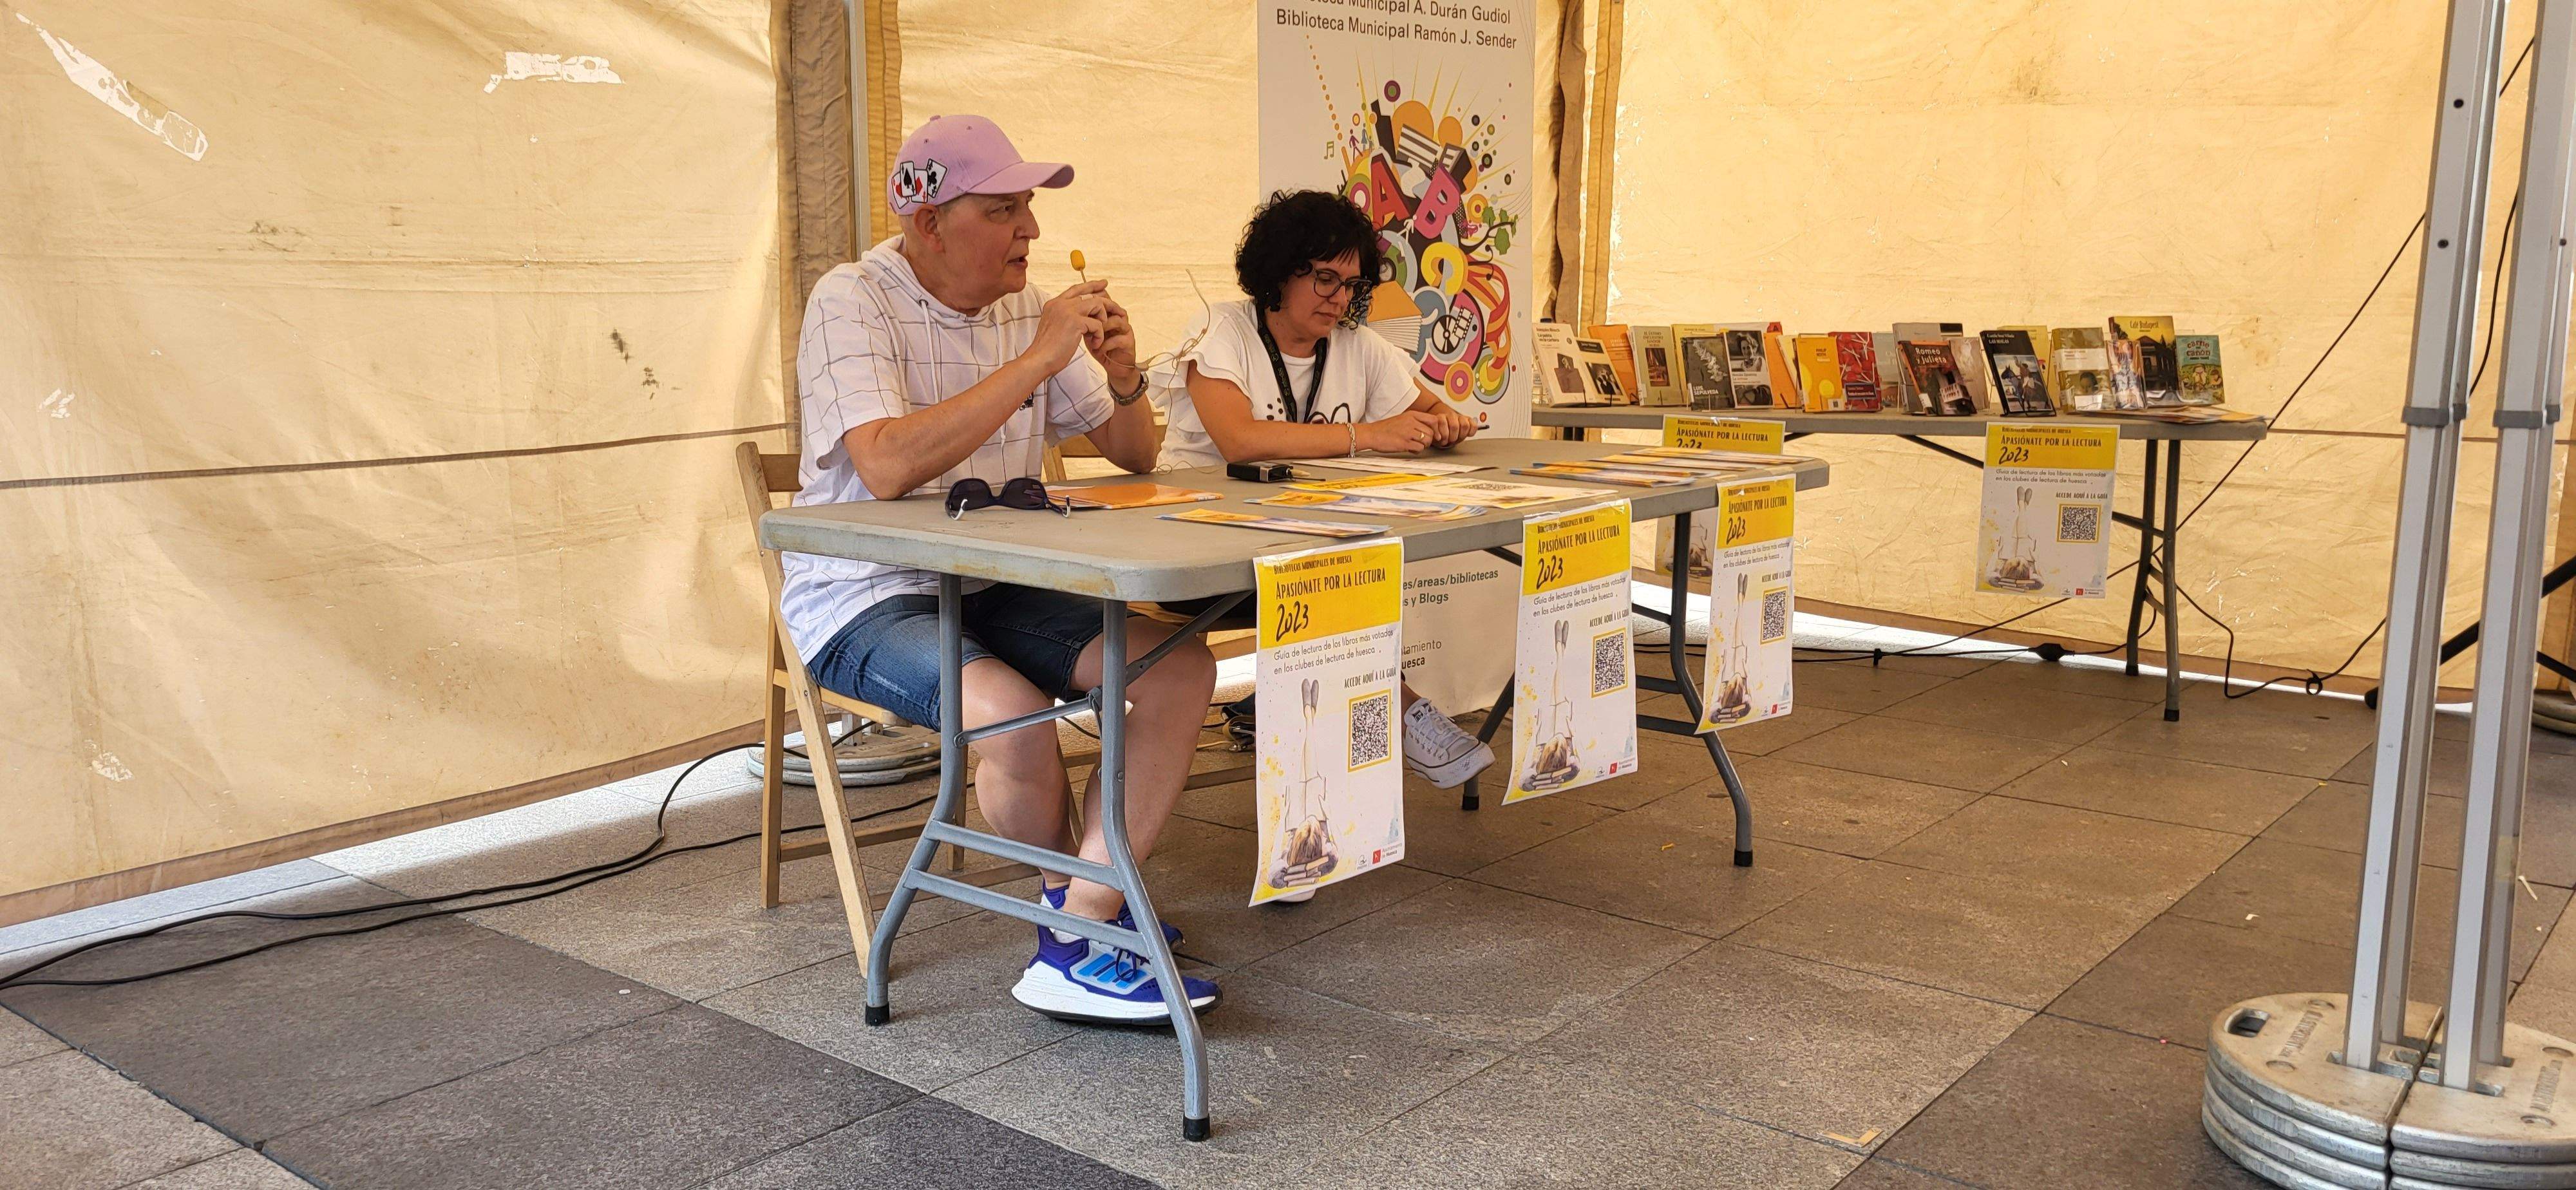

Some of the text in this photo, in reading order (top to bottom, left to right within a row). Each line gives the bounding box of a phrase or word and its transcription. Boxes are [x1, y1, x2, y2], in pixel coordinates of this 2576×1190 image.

[1414, 0, 1426, 14] A.
[1430, 1, 1467, 19] Durán
[1472, 5, 1510, 24] Gudiol
[1276, 8, 1517, 49] Biblioteca Municipal Ramón J. Sender
[1915, 347, 1940, 355] Romeo
[1676, 427, 1714, 439] APASIÓNATE
[1741, 433, 1768, 442] LECTURA
[2001, 435, 2101, 447] APASIÓNATE POR LA LECTURA
[1998, 446, 2029, 464] 2023
[1537, 524, 1620, 554] APASIÓNATE POR LA LECTURA
[1726, 516, 1746, 545] 2023
[1336, 555, 1352, 565] HUESCA
[1276, 567, 1386, 600] APASIÓNATE POR LA LECTURA
[1403, 570, 1499, 590] es/areas/bibliotecas
[1536, 555, 1564, 590] 2023
[1412, 597, 1417, 608] y
[1419, 592, 1449, 604] Blogs
[1276, 601, 1309, 642] 2023
[1274, 628, 1393, 661] Guía de lectura de los libros más votados
[1401, 640, 1442, 655] tamiento
[1274, 647, 1376, 675] en los clubes de lectura de huesca
[1401, 656, 1425, 669] uesca
[1344, 665, 1396, 689] ACCEDE AQUÍ A LA GUÍA
